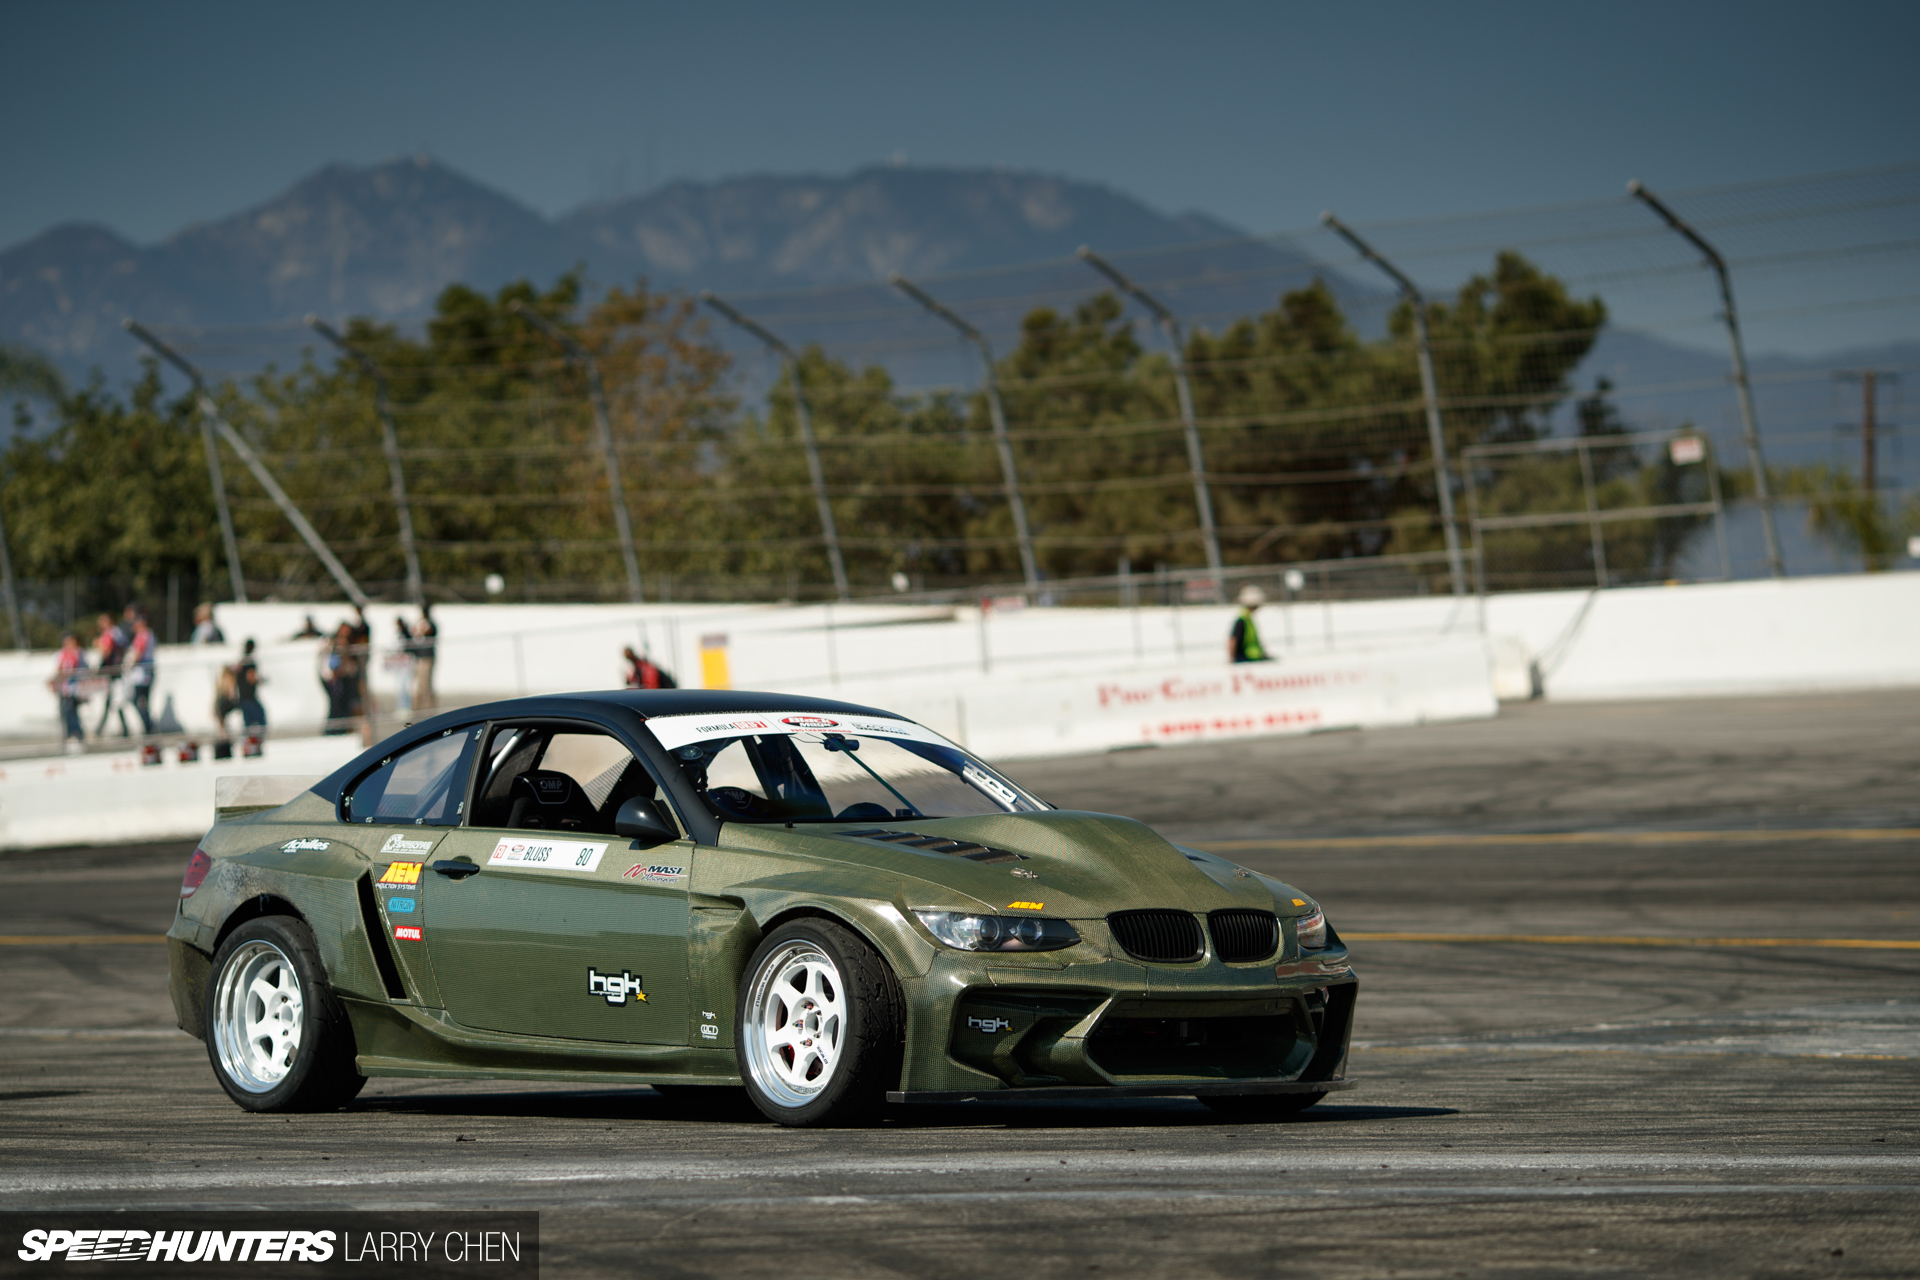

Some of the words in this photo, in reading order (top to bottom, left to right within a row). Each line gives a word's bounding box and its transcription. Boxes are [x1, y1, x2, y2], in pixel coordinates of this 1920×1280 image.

[695, 723, 737, 733] FORMULA
[540, 780, 563, 790] OMP
[280, 838, 331, 851] Achilles
[523, 846, 552, 861] BLUSS
[575, 848, 594, 866] 80
[379, 861, 423, 885] AEM
[1005, 900, 1045, 911] AEM
[396, 927, 421, 940] MOTUL
[589, 970, 641, 1003] hgk
[968, 1015, 1009, 1033] hgk
